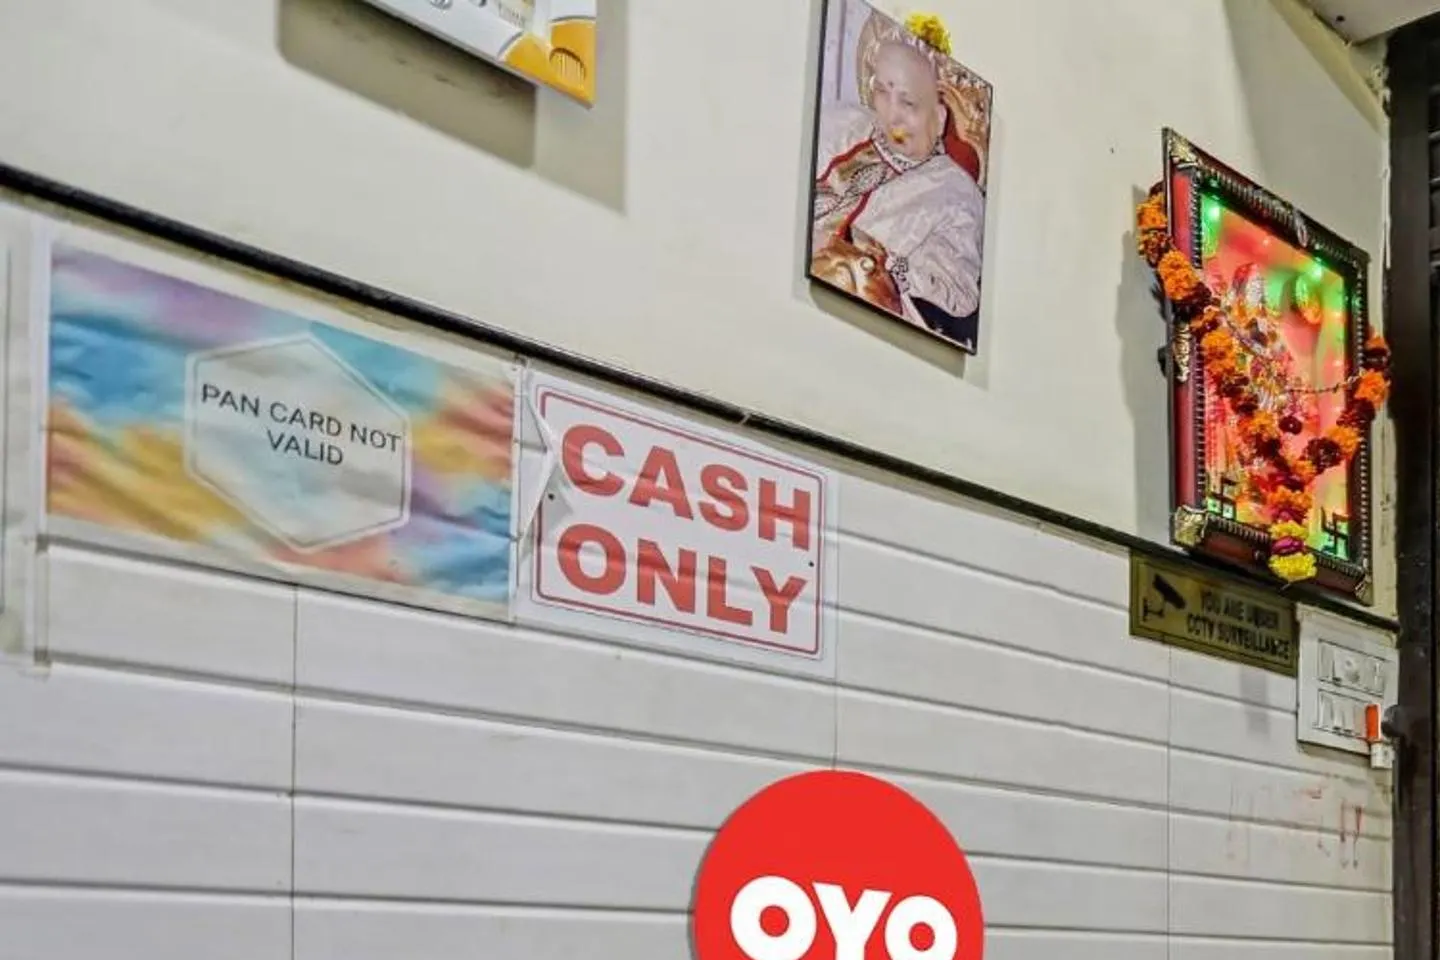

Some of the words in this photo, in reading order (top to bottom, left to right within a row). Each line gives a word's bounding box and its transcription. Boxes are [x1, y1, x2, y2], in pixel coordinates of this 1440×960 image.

[201, 383, 260, 417] PAN
[270, 402, 342, 437] CARD
[350, 423, 402, 452] NOT
[267, 428, 343, 465] VALID
[561, 423, 811, 552] CASH
[557, 523, 808, 635] ONLY
